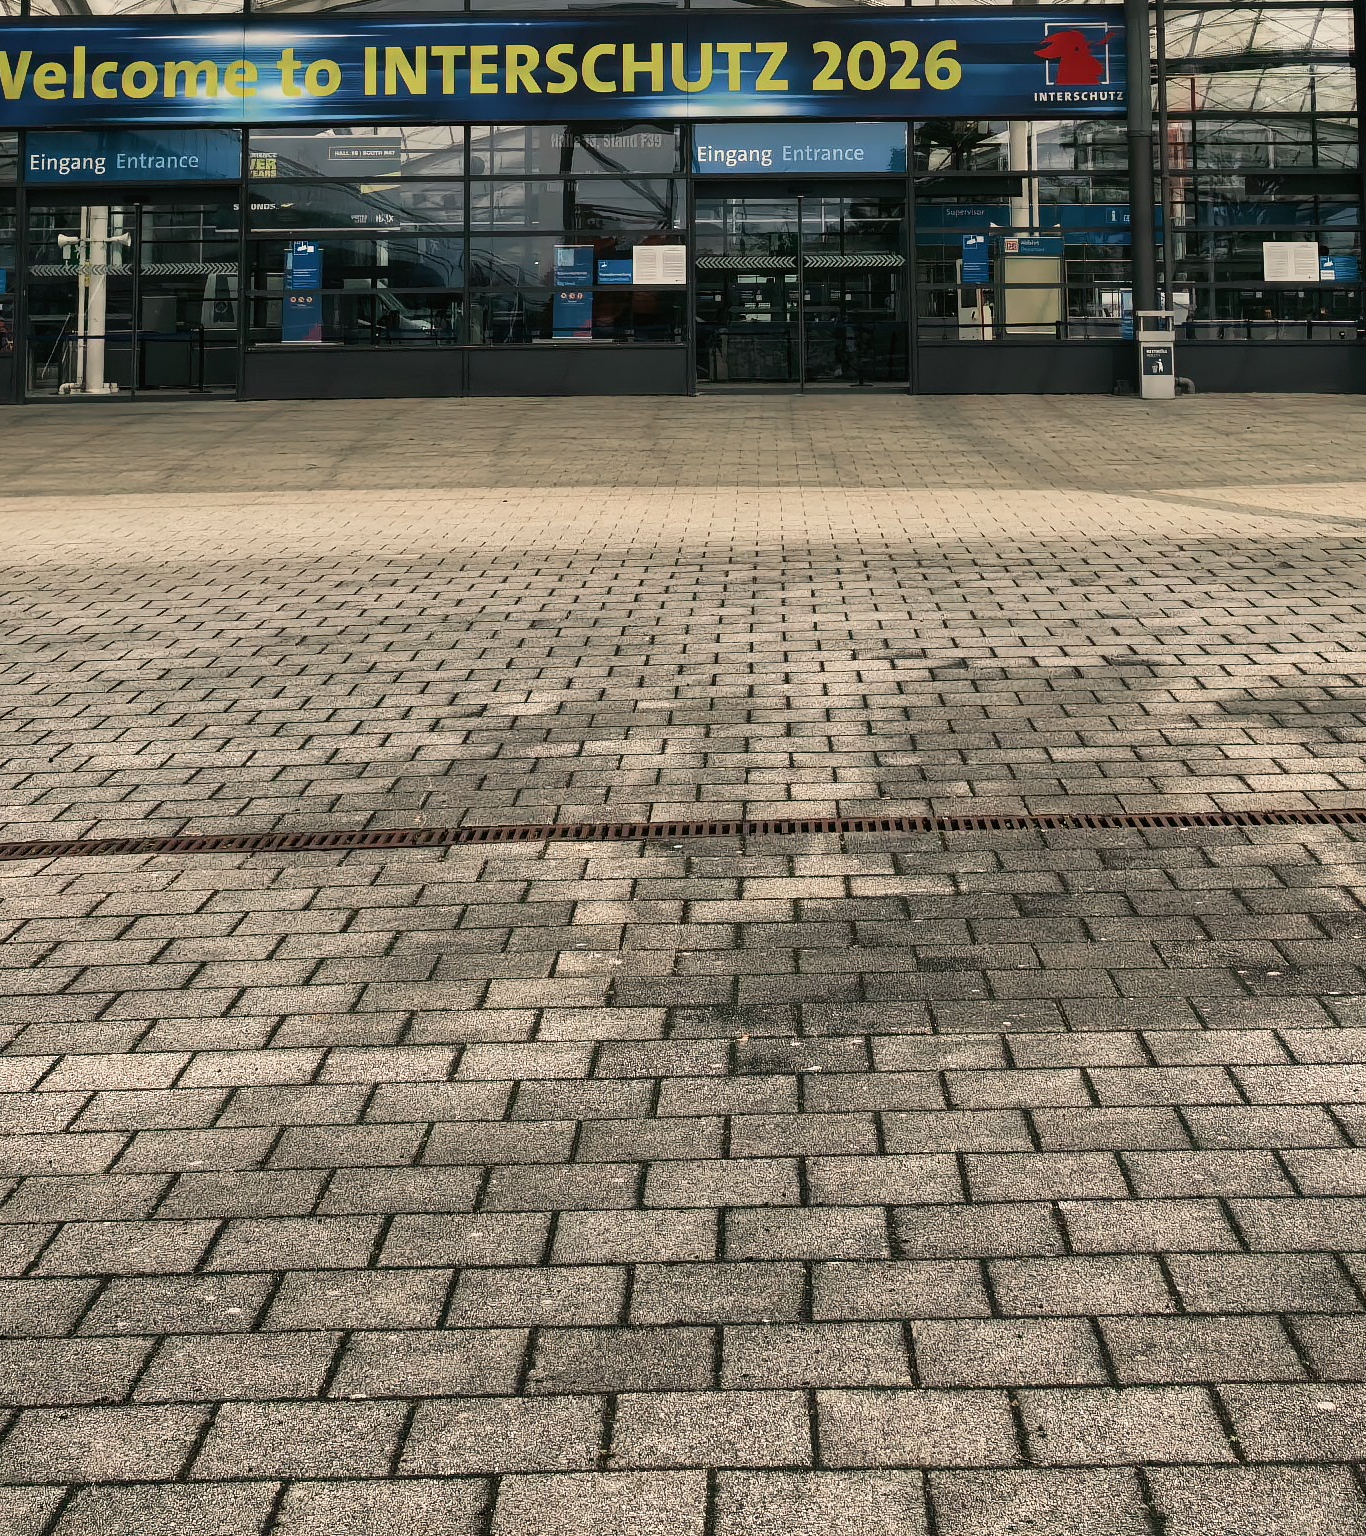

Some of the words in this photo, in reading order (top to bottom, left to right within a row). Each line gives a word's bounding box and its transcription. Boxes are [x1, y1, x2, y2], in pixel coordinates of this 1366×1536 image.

[276, 47, 342, 98] to
[363, 41, 789, 96] INTERSCHUTZ
[812, 39, 962, 91] 2026
[1034, 91, 1124, 102] INTERSCHUTZ
[30, 153, 106, 175] Eingang
[116, 152, 199, 170] Entrance
[697, 145, 772, 167] Eingang
[782, 145, 864, 162] Entrance
